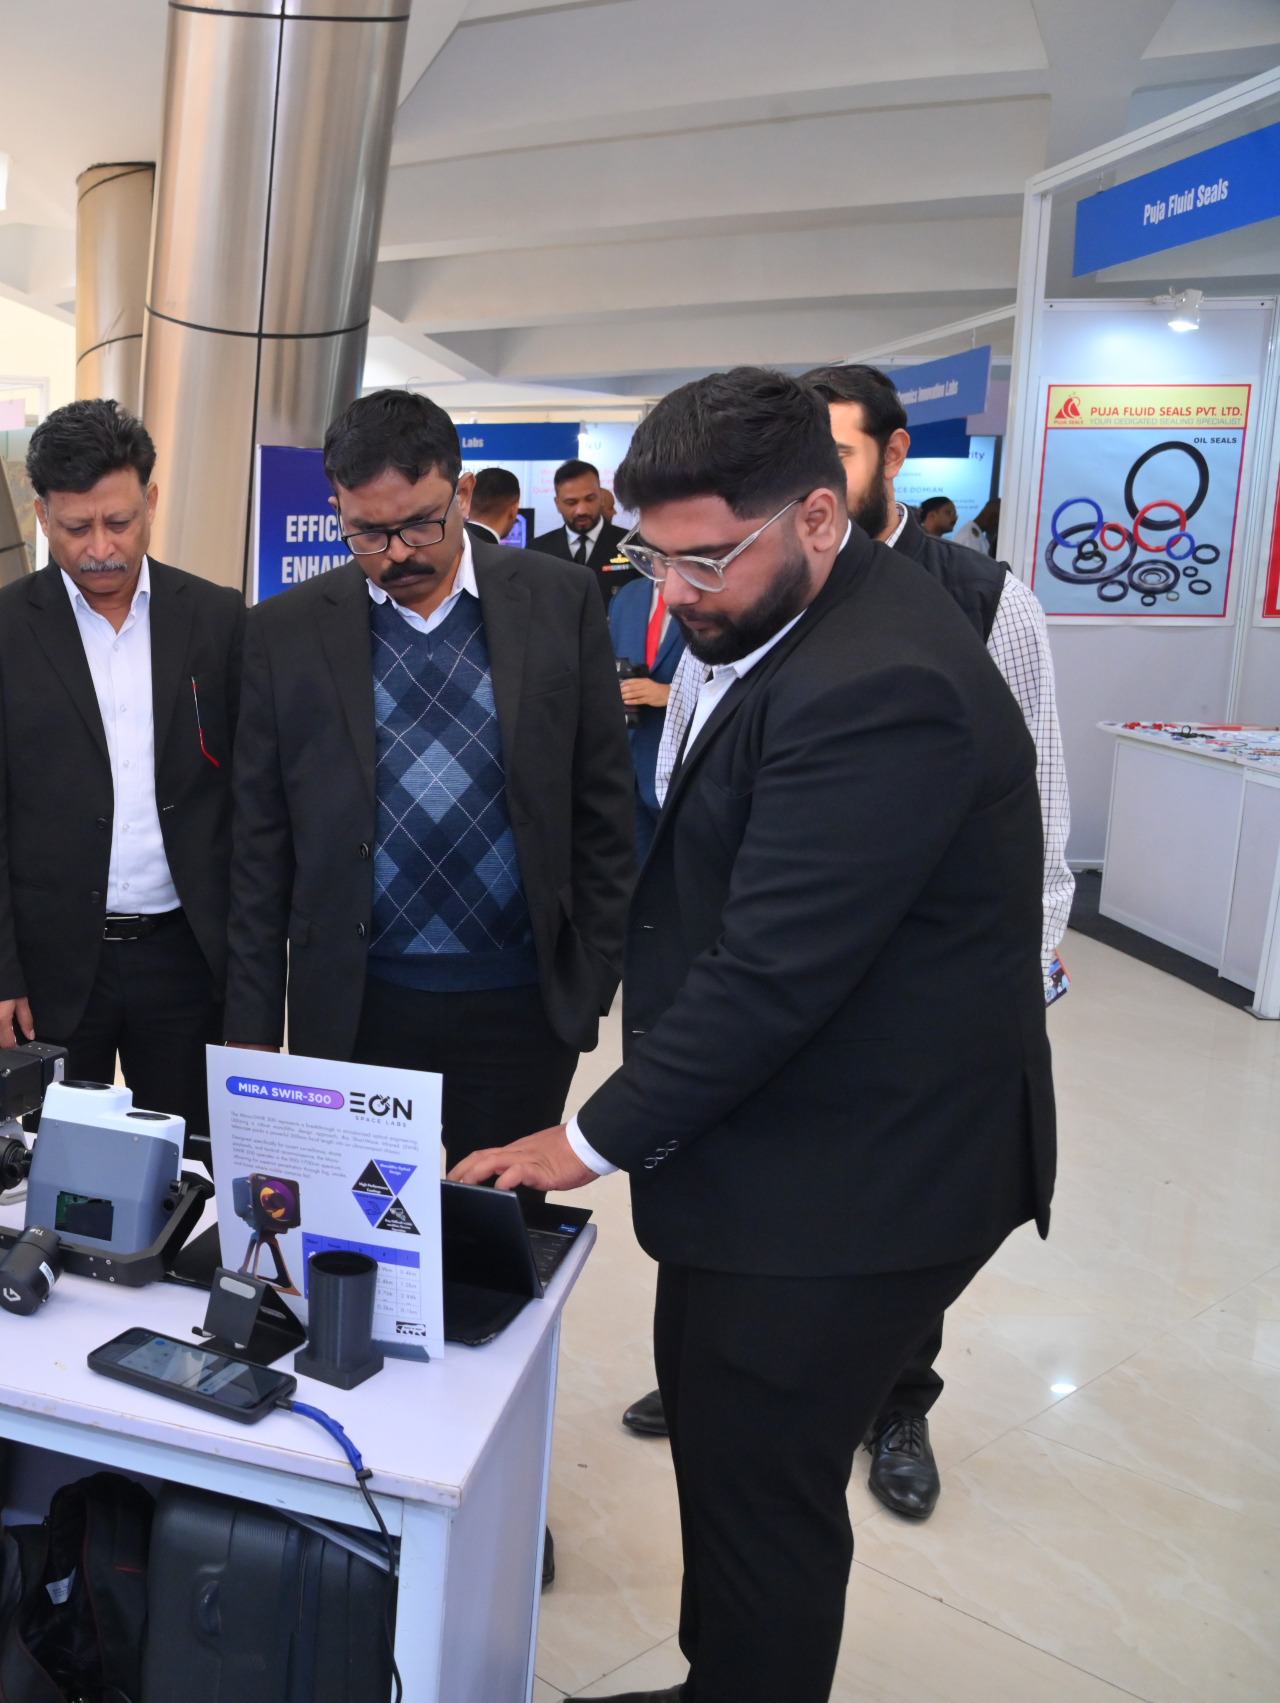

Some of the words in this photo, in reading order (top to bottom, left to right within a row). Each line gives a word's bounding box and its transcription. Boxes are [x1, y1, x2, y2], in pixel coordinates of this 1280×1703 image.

[1143, 200, 1166, 226] Puja
[1167, 187, 1195, 218] Fluid
[1196, 178, 1229, 208] Seals
[945, 379, 959, 397] Labs
[1090, 406, 1119, 417] PUJA
[1123, 406, 1156, 417] FLUID
[1159, 406, 1192, 417] SEALS
[1196, 406, 1218, 417] PVT.
[1221, 406, 1243, 417] LTD.
[1089, 417, 1112, 425] YOUR
[1114, 417, 1158, 425] DEDICATED
[1159, 417, 1194, 425] SEALING
[1196, 417, 1242, 425] SPECIALIST
[462, 437, 484, 448] Labs
[282, 555, 354, 583] ENHA
[238, 1082, 269, 1096] MIRA
[271, 1088, 332, 1105] SWIR-300
[355, 1115, 381, 1124] SPACE
[385, 1120, 407, 1128] LABS
